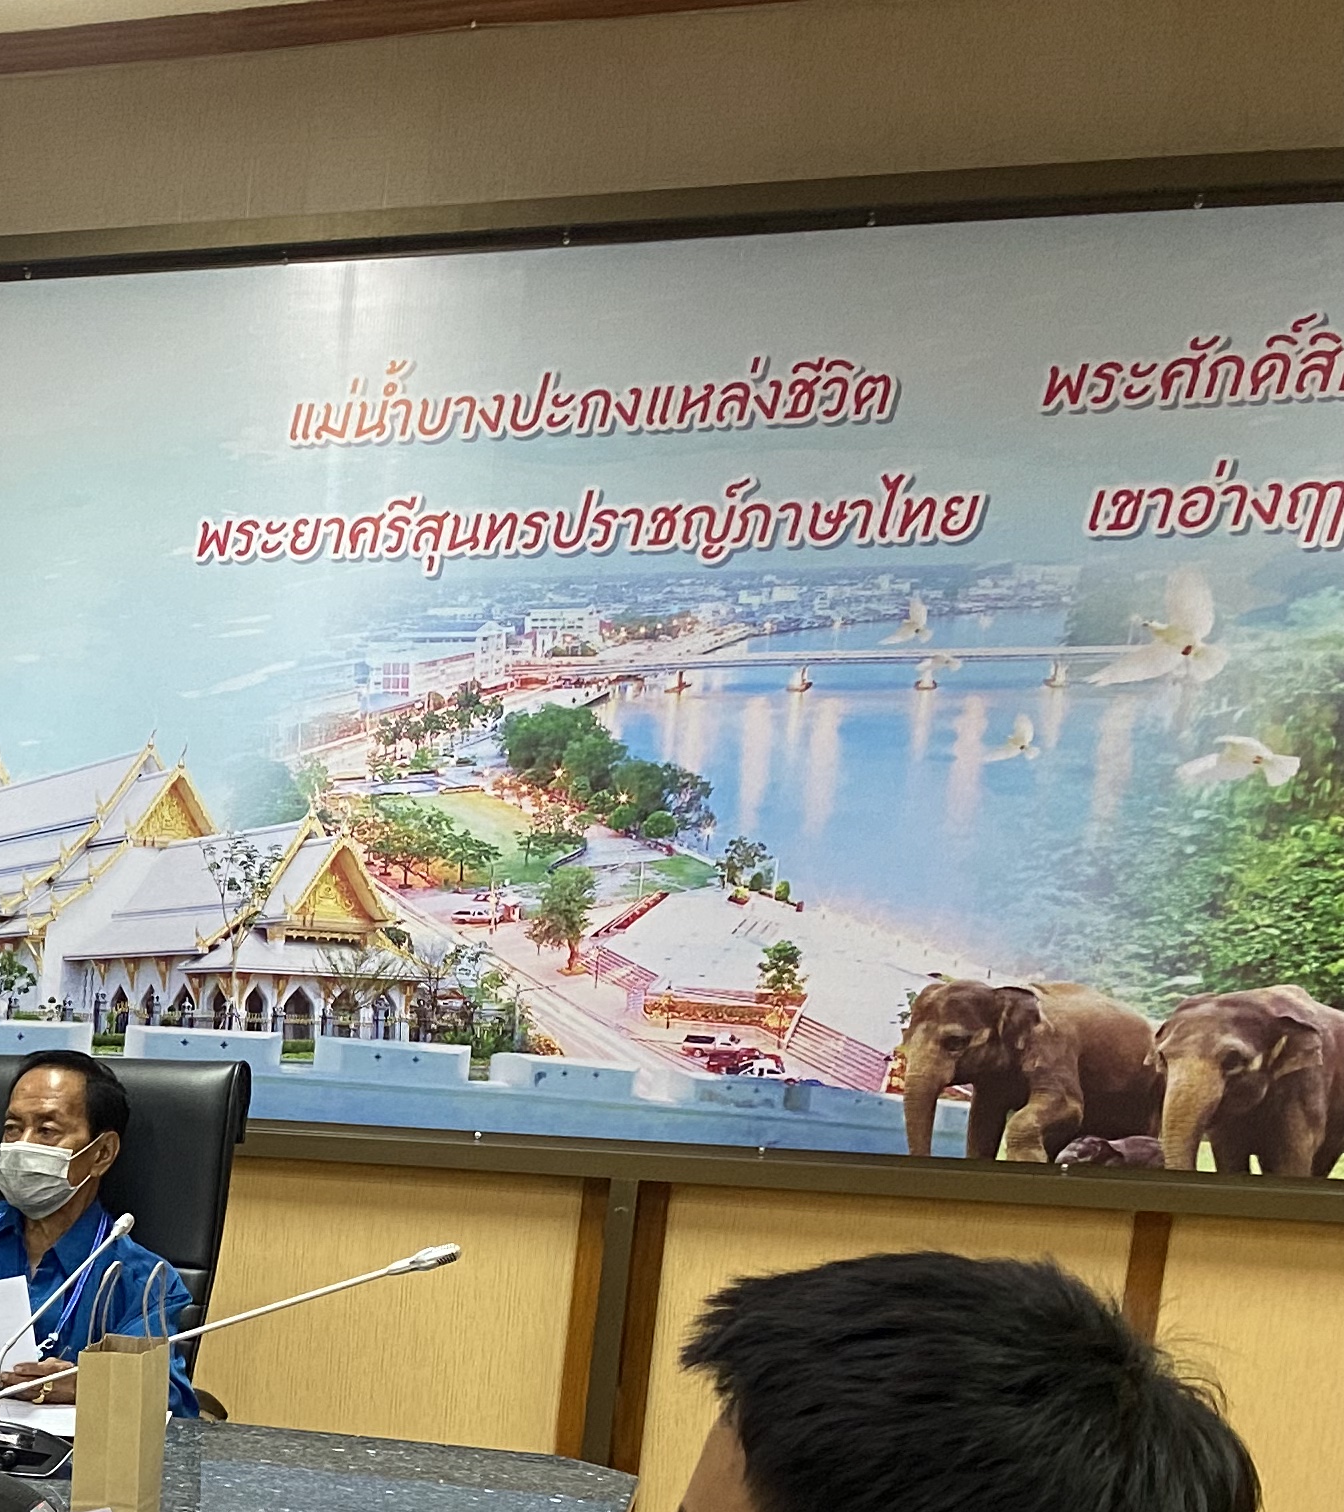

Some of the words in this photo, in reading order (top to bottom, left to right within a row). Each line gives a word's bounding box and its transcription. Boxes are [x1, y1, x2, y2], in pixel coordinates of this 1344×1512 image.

[290, 358, 894, 444] แม่น้ำบางปะกงแหล่งชีวิต
[1042, 312, 1344, 407] พระศักดิ์สิ
[196, 476, 980, 573] พระยาศรีสุนทรปราชญ์ภาษาไทย
